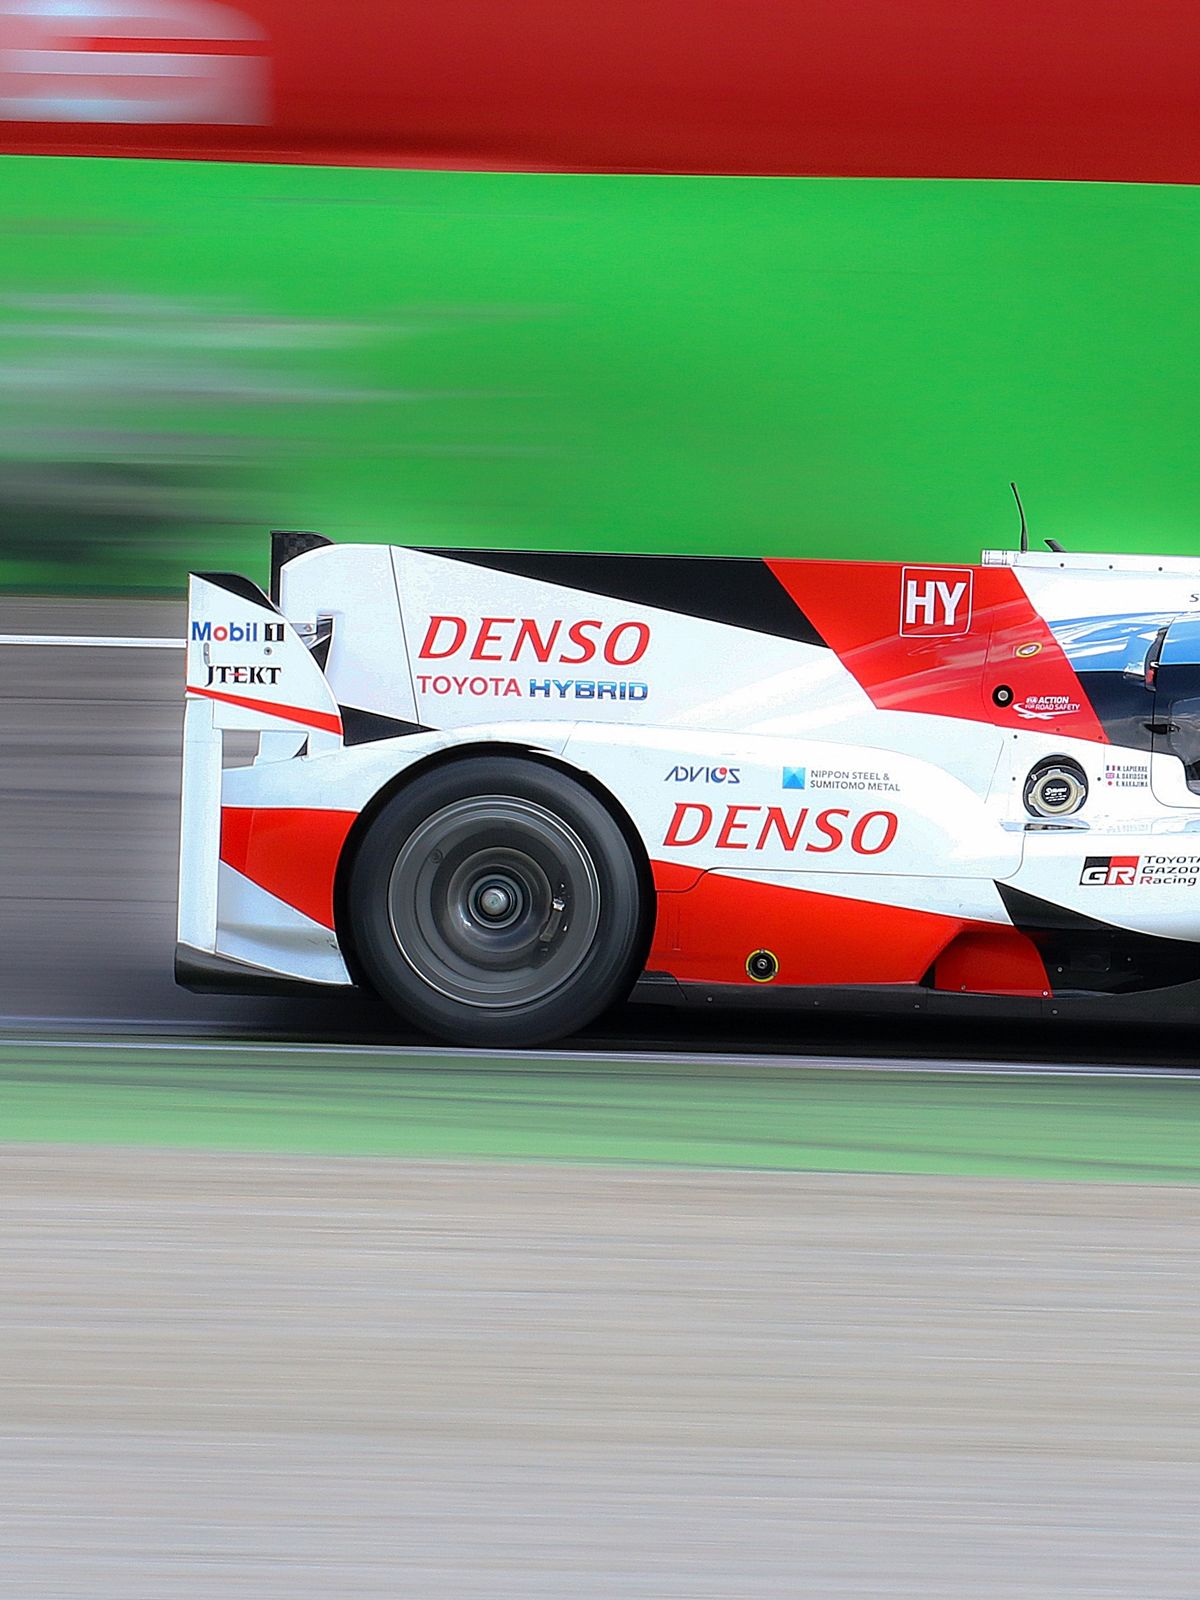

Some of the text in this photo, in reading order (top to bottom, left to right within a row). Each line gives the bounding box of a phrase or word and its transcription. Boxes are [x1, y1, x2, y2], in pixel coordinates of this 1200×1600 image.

[906, 579, 968, 626] HY
[191, 621, 285, 642] Mobil 1
[418, 615, 651, 667] DENSO
[204, 665, 282, 688] JTEKT
[416, 674, 649, 701] TOYOTA HYBRID
[1035, 703, 1054, 711] ROAD
[1055, 703, 1081, 711] SAFETY
[1038, 696, 1070, 704] ACTION
[664, 766, 741, 785] ADVICS
[810, 770, 890, 781] NIPPON STEEL &
[810, 779, 901, 792] SUMITOMO METAL
[662, 802, 899, 856] DENSO
[1081, 866, 1137, 885] GR
[1141, 865, 1200, 875] GAZOO
[1139, 875, 1198, 887] Racing
